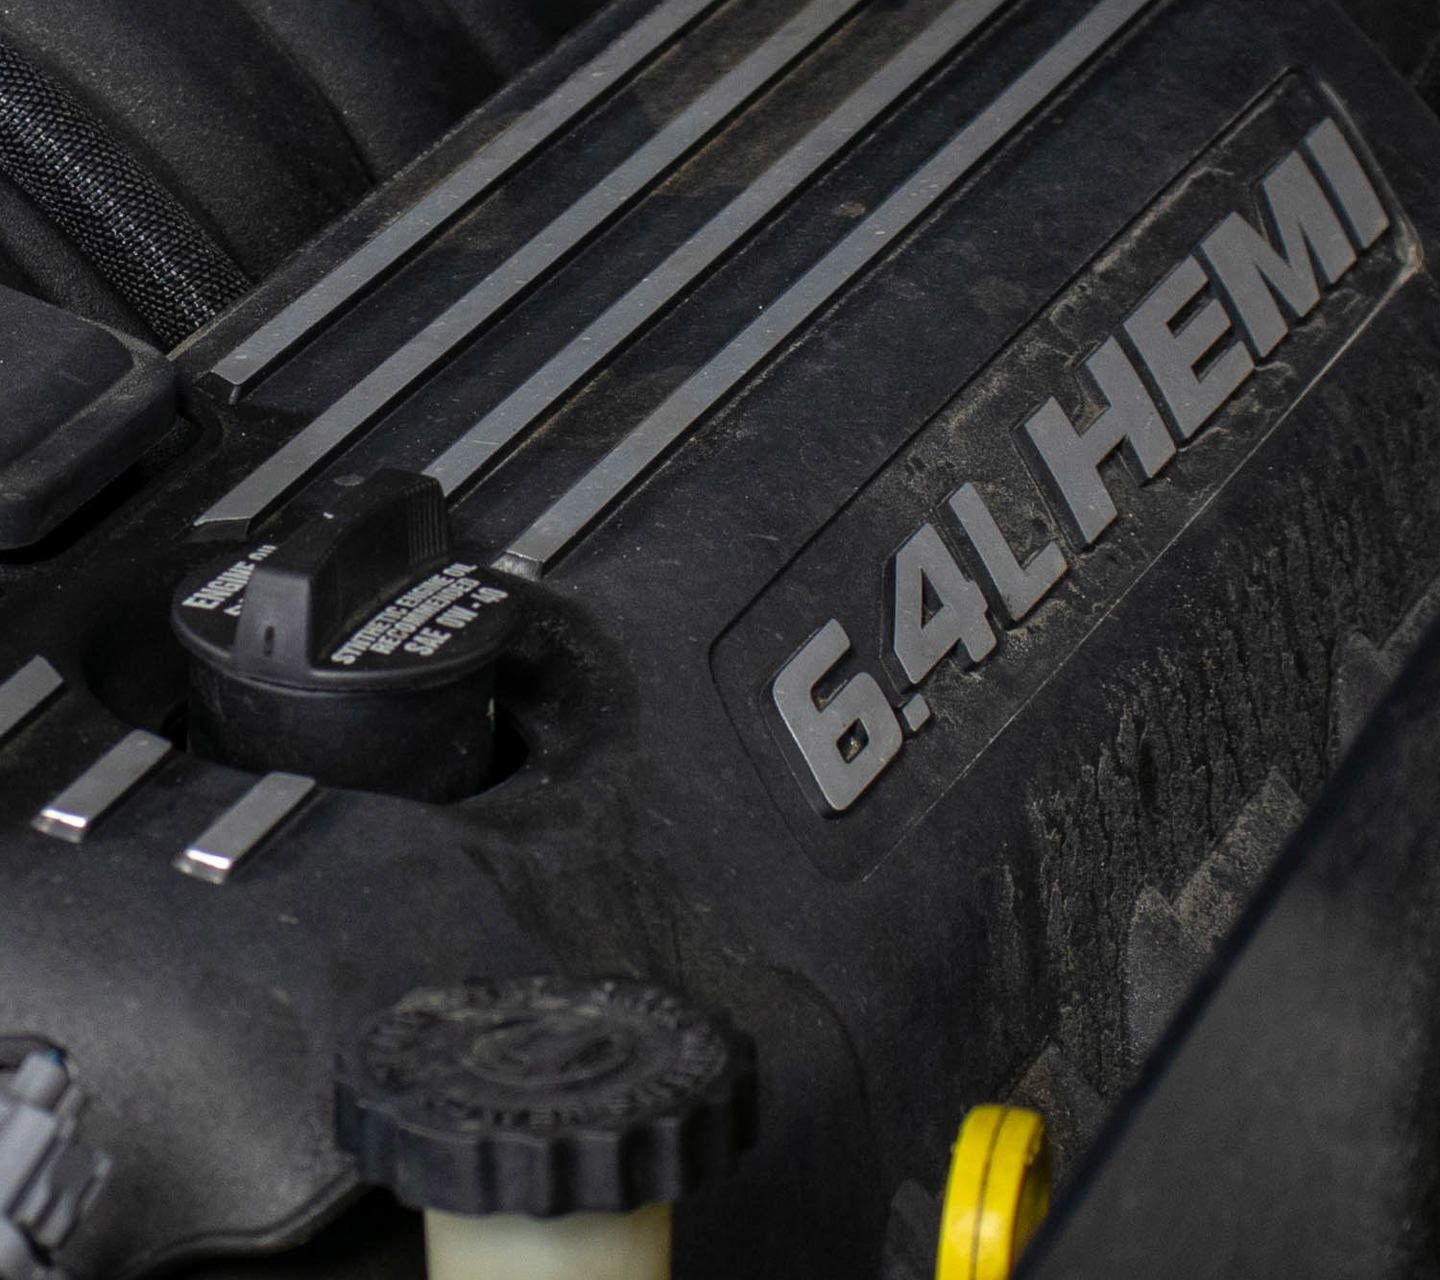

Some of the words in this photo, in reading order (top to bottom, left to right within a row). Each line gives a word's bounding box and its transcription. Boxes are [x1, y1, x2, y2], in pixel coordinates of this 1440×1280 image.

[182, 561, 255, 609] ENGINE
[331, 605, 409, 665] SYNTHETIC
[395, 574, 456, 608] ENGINE
[443, 562, 478, 577] OIL
[370, 577, 481, 655] RECOMMENDED
[403, 627, 452, 656] SAE
